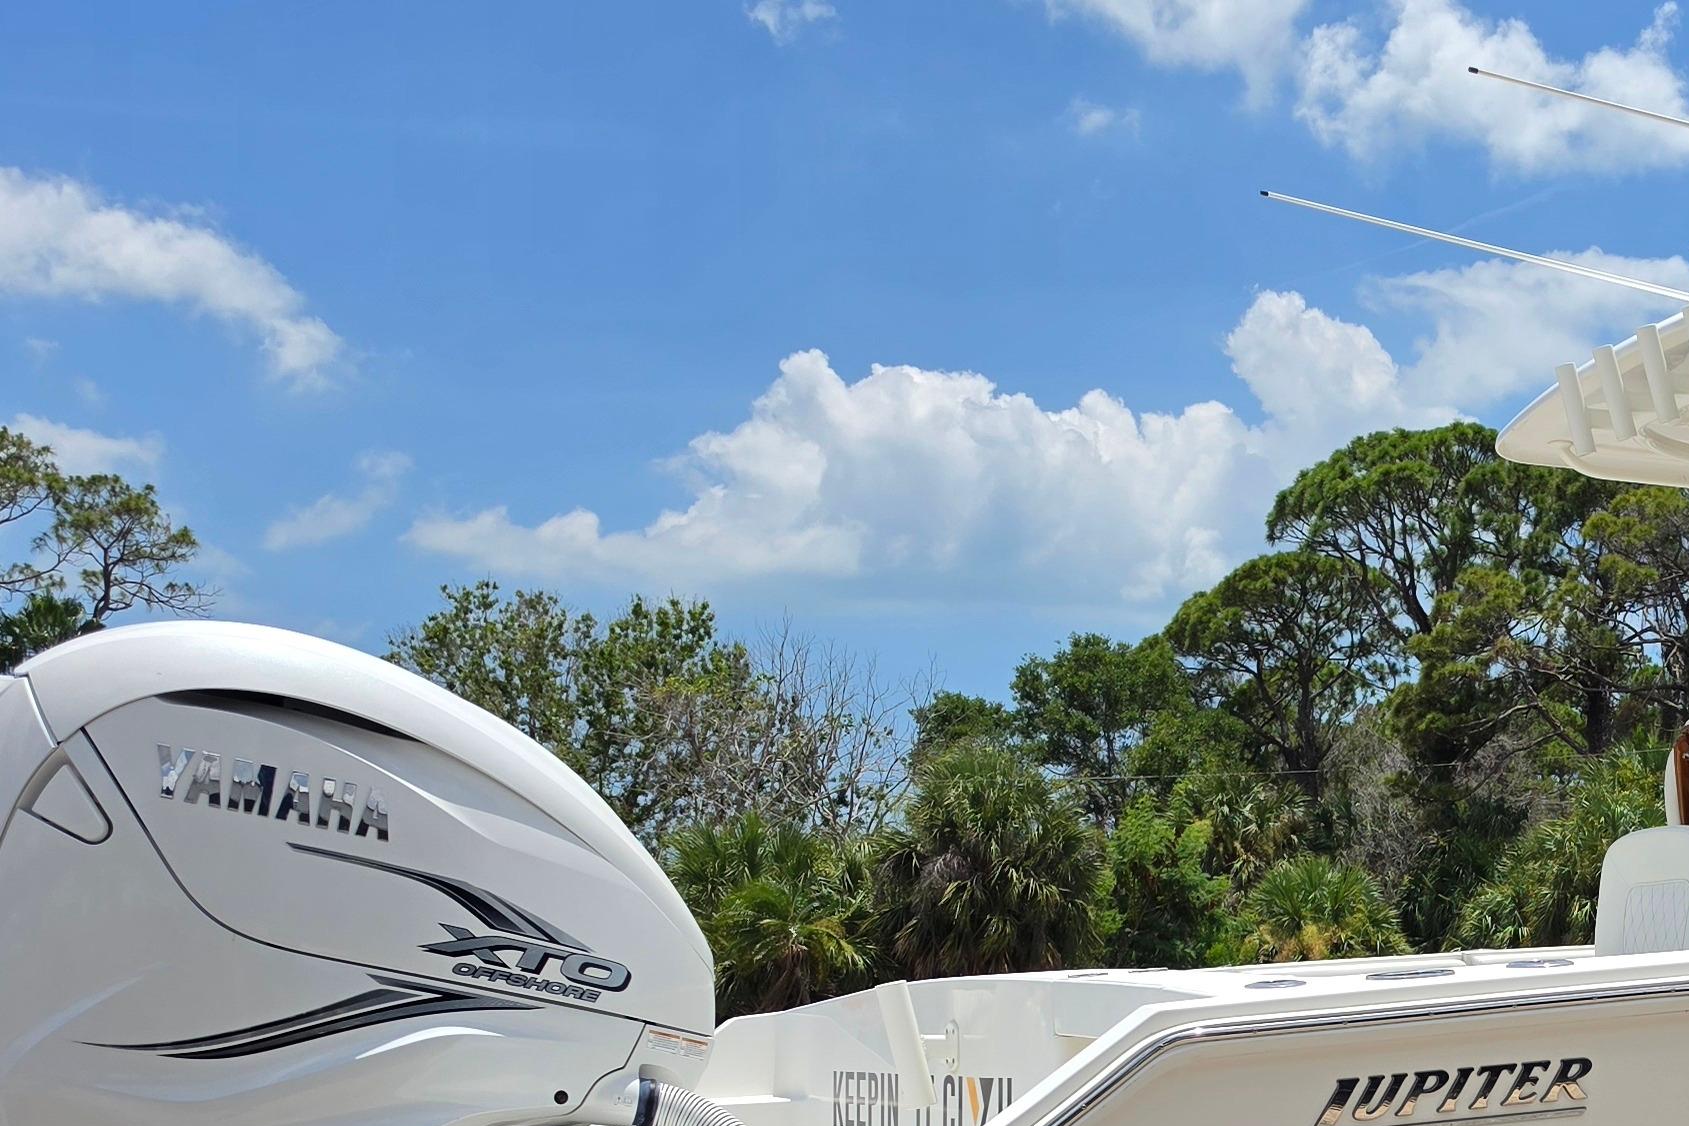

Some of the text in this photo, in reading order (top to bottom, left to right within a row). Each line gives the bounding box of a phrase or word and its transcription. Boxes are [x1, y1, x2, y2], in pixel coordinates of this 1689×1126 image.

[157, 743, 389, 842] YAMAHA
[417, 922, 632, 992] XTO
[452, 962, 602, 1003] OFFSHORE
